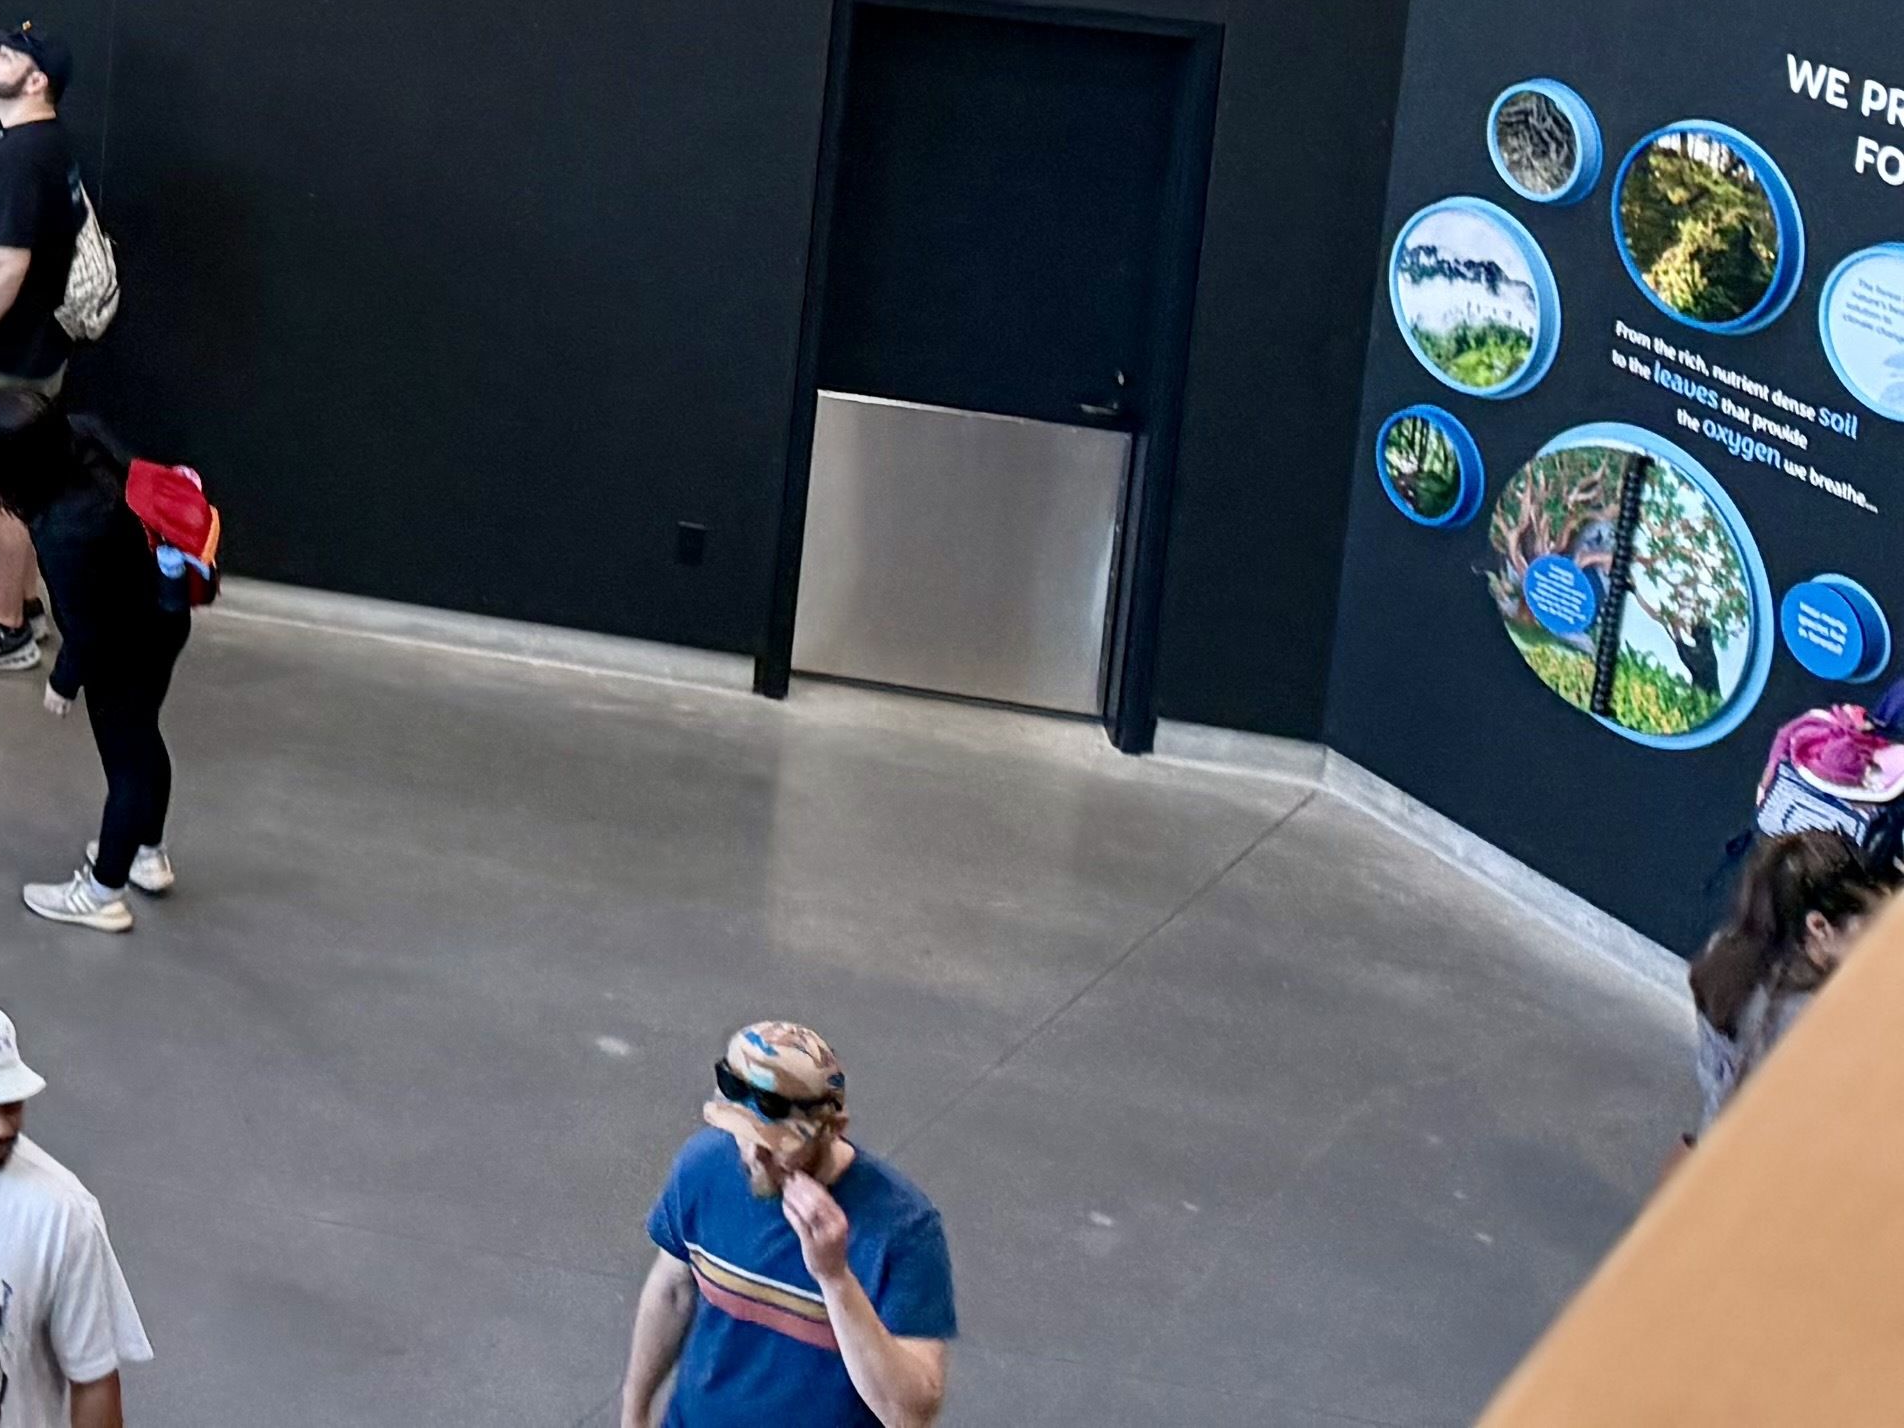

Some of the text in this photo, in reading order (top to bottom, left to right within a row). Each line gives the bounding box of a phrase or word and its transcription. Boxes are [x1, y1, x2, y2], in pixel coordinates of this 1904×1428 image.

[1786, 53, 1851, 110] WE
[1855, 135, 1904, 186] FO
[1611, 348, 1809, 451] to the leaves that provide
[1615, 319, 1858, 441] From the rich, nutrient dense soil
[1676, 407, 1701, 433] the
[1702, 419, 1782, 471] oxygen
[1783, 457, 1808, 482] we
